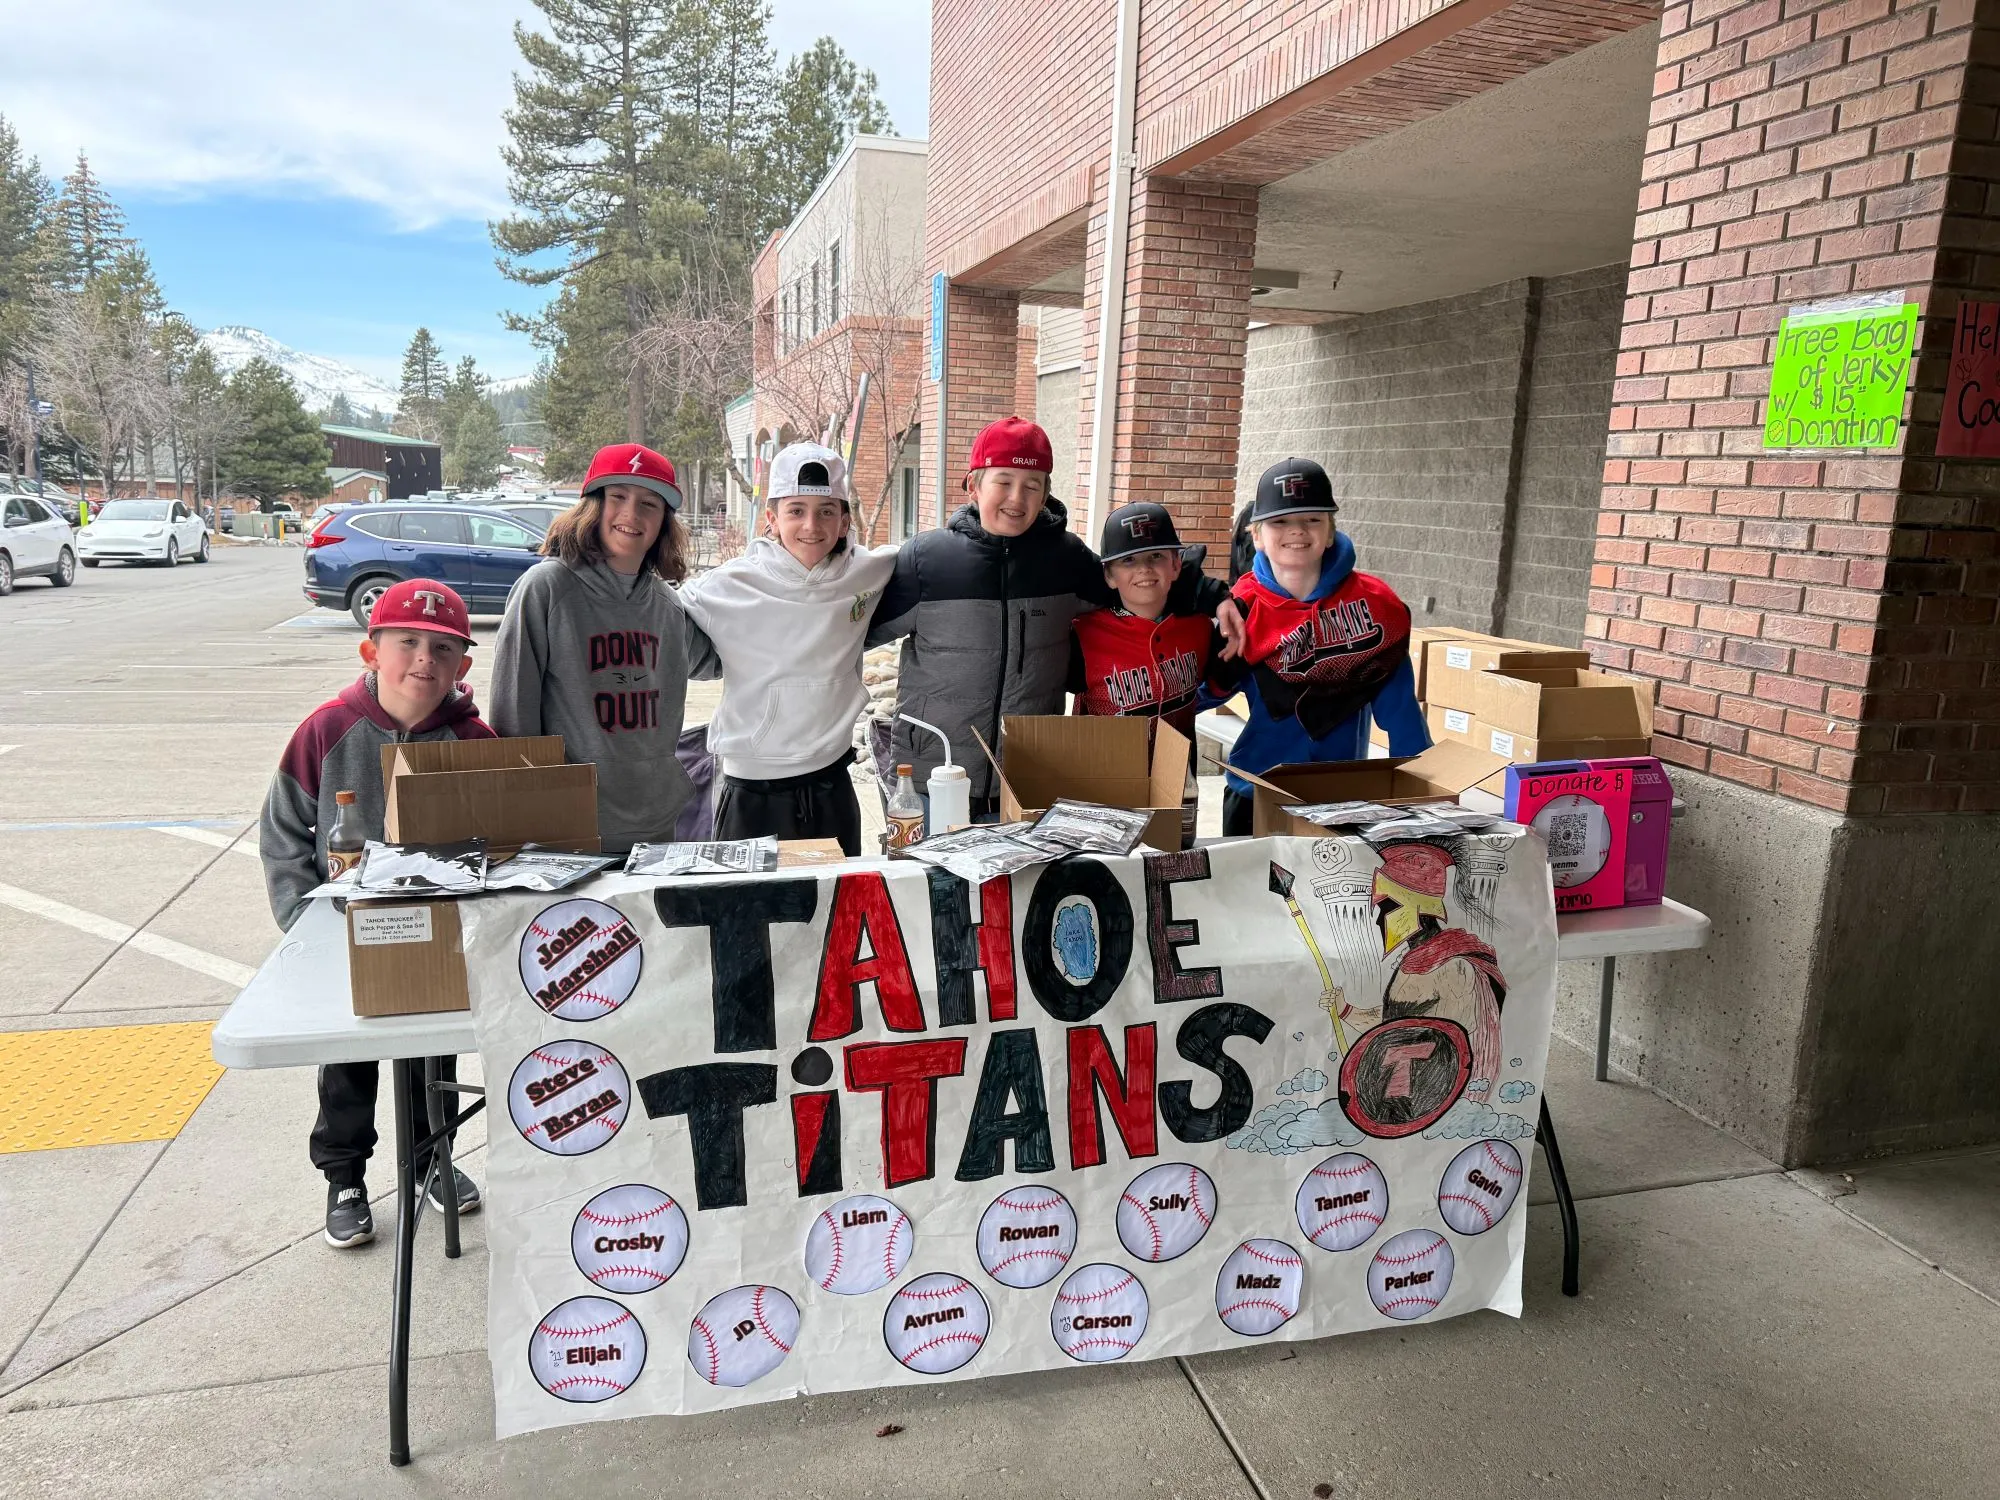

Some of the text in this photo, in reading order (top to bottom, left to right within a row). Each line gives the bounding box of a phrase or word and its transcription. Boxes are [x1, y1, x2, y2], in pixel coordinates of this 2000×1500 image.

[1781, 311, 1908, 357] Free Bag
[1799, 352, 1906, 393] of Jerky
[1786, 412, 1900, 447] Donation
[1012, 457, 1038, 466] GRANT
[414, 590, 446, 616] T
[1318, 598, 1376, 648] TITANS
[588, 630, 660, 673] DON'T
[1104, 664, 1154, 707] TAHOE
[593, 689, 660, 735] QUIT
[1528, 772, 1625, 798] Donate $
[1552, 861, 1579, 869] venmo
[536, 916, 597, 967] John
[653, 848, 1224, 1054] TAHOE
[535, 923, 638, 1009] Marshall
[525, 1057, 597, 1103] Steve
[1381, 1041, 1437, 1100] T
[541, 1088, 622, 1138] Bryan
[337, 1188, 362, 1204] NIKE
[1467, 1168, 1503, 1199] Gavin
[1149, 1193, 1191, 1212] Sully
[1314, 1189, 1372, 1212] Tanner
[842, 1207, 888, 1229] Liam
[594, 1232, 664, 1253] Crosby
[998, 1221, 1060, 1243] Rowan
[1235, 1274, 1282, 1290] Madz
[1384, 1267, 1435, 1292] Parker
[732, 1319, 756, 1342] JD
[902, 1304, 965, 1332] Avrum
[1073, 1314, 1133, 1331] Carson
[566, 1343, 622, 1366] Elijah
